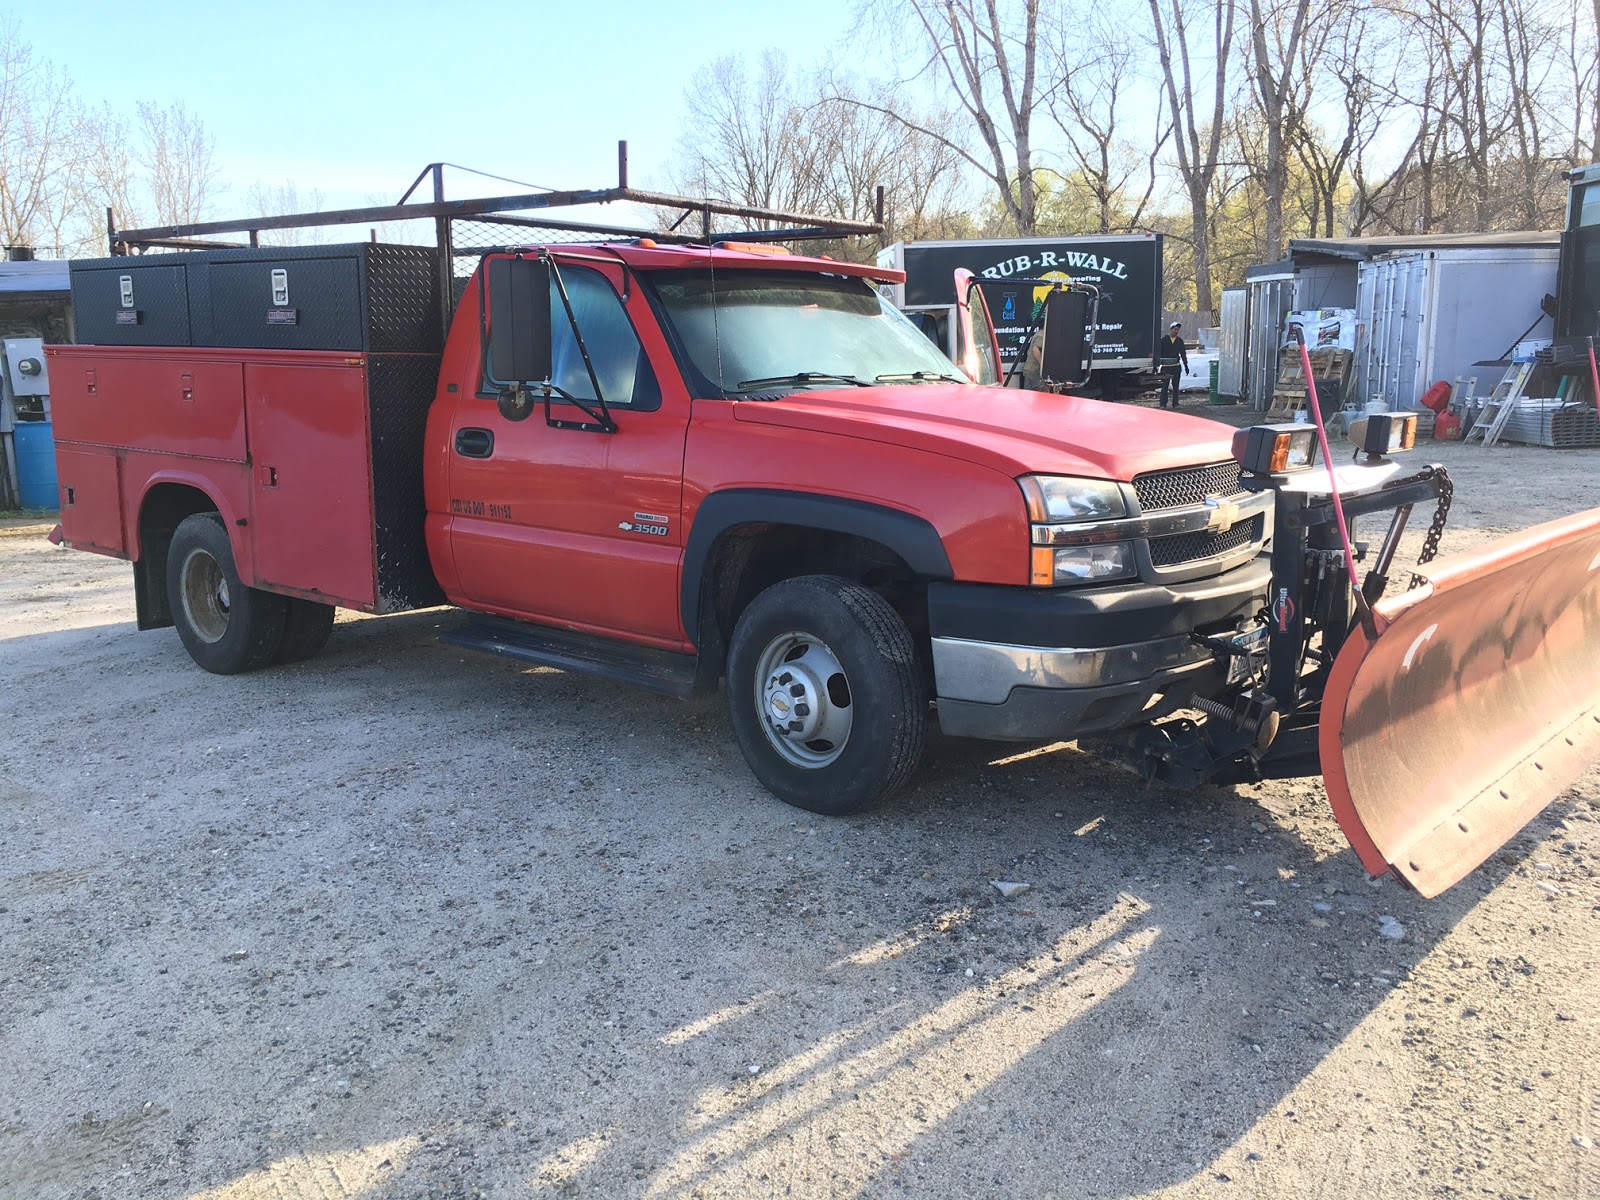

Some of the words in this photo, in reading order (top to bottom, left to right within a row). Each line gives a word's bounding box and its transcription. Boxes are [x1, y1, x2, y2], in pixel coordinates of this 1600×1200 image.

[981, 251, 1128, 280] RUB-R-WALL
[994, 326, 1025, 334] oundation
[1085, 323, 1100, 331] rak
[1101, 322, 1123, 331] Repair
[463, 500, 471, 514] US
[472, 501, 485, 516] DOT
[633, 523, 668, 536] 3500
